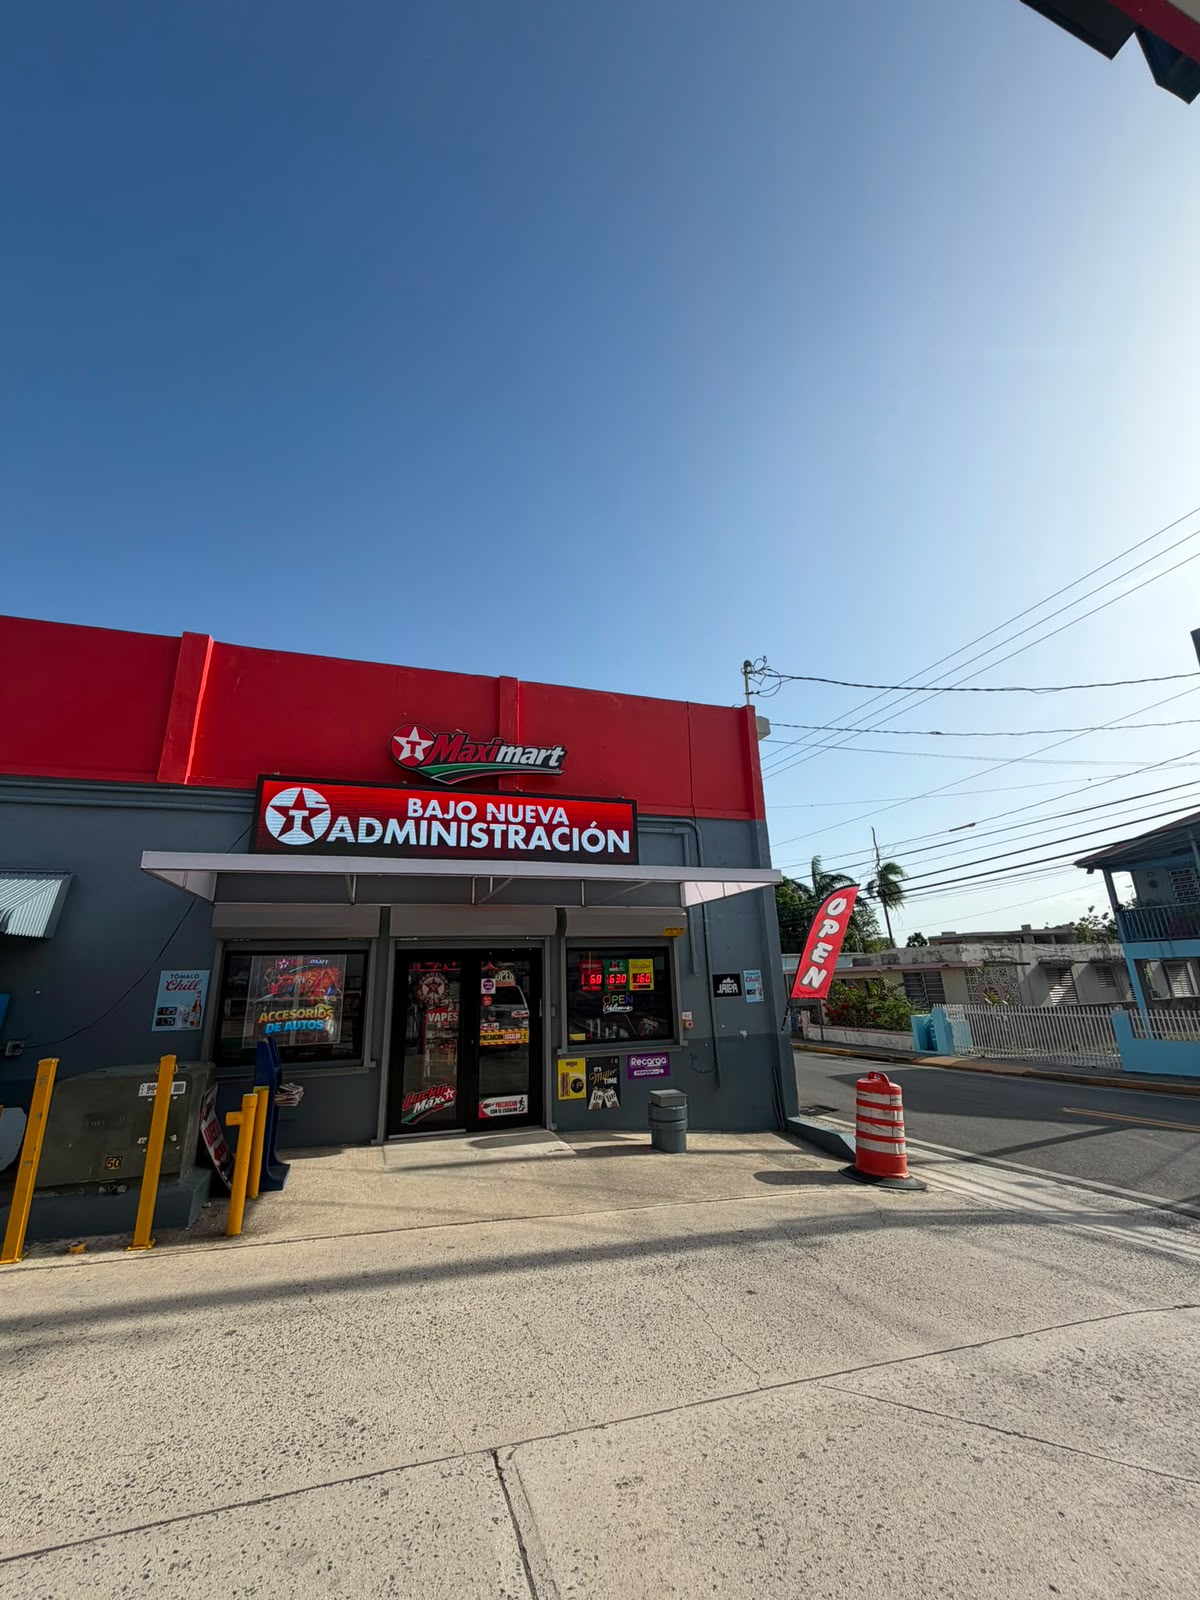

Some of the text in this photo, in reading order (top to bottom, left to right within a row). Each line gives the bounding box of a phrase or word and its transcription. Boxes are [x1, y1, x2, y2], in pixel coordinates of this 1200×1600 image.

[421, 734, 564, 767] Maximart
[407, 798, 569, 825] BAJO NUEVA
[327, 817, 631, 854] ADMINISTRACIÓN
[802, 898, 847, 989] OPEN
[165, 980, 200, 991] Chill
[602, 995, 633, 1004] OPEN
[258, 1009, 334, 1023] ACCESORIOS
[428, 1012, 458, 1021] VAPES
[264, 1020, 324, 1034] DE AUTOS
[631, 1057, 667, 1067] Recarga
[589, 1068, 618, 1085] Miller
[603, 1077, 618, 1086] TIME
[107, 1158, 121, 1168] 50
